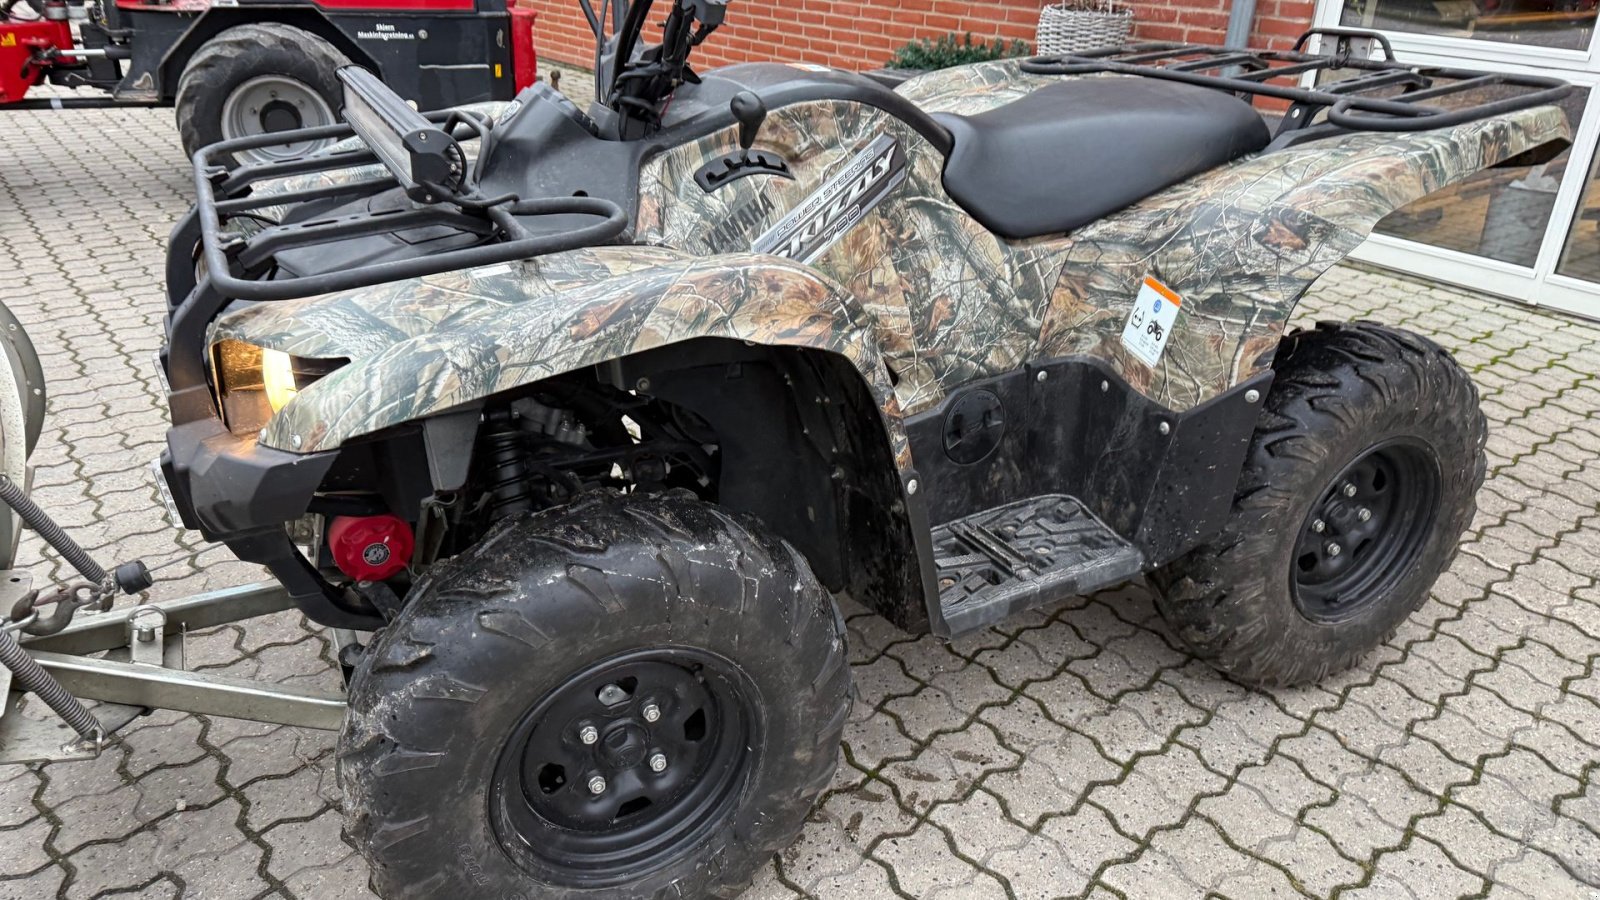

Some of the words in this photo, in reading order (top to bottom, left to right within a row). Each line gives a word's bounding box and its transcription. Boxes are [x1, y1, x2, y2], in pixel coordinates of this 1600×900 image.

[701, 193, 775, 253] YAMAHA
[777, 196, 821, 239] POWER
[824, 148, 875, 200] STEERING
[823, 204, 862, 245] 700
